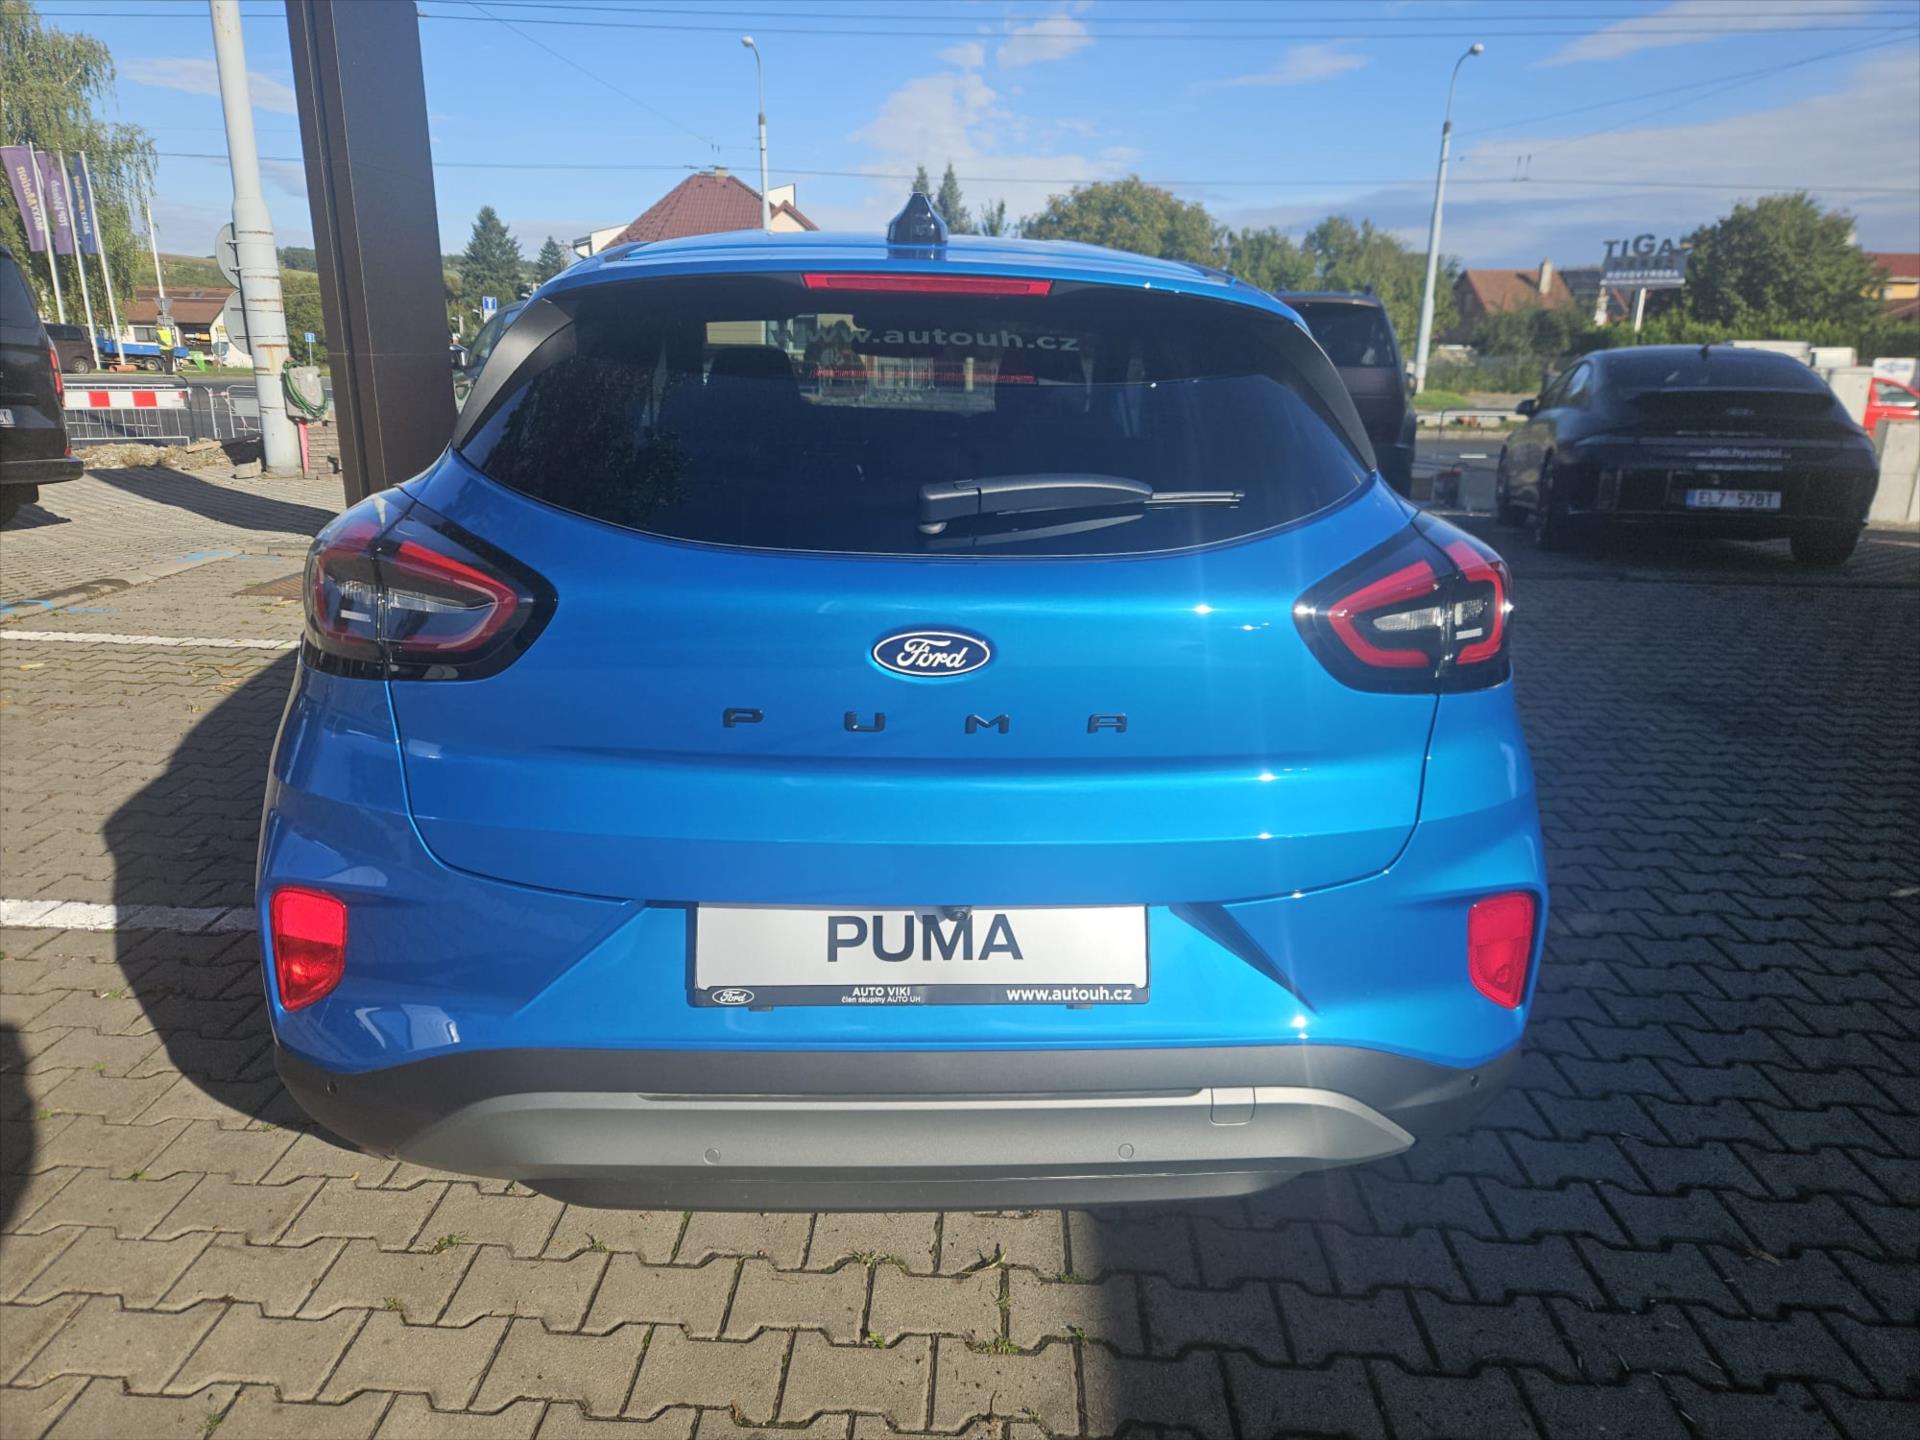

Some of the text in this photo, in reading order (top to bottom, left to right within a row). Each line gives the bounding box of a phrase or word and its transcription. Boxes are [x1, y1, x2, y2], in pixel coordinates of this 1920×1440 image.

[896, 638, 969, 668] Ford
[723, 707, 1128, 734] PUMA
[827, 913, 1024, 963] PUMA
[720, 990, 747, 1002] Ford
[852, 986, 911, 997] AUTO VIKI
[1006, 986, 1133, 1000] www.autouh.cz
